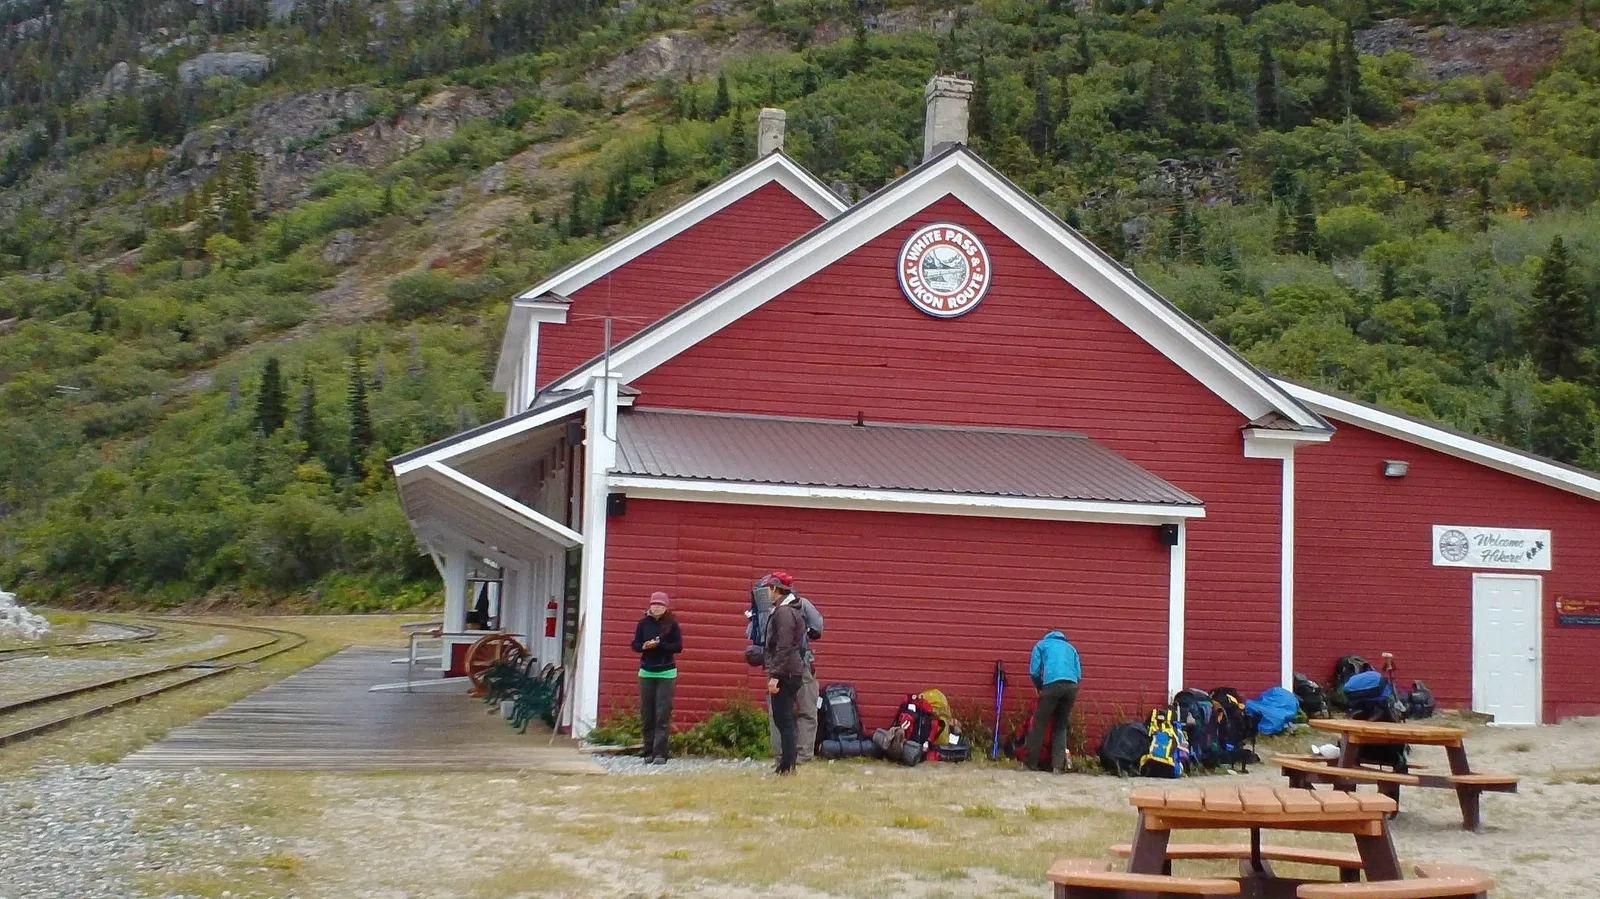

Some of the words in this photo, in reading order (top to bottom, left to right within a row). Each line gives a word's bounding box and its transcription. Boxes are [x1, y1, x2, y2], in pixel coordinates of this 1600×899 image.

[907, 230, 942, 261] WHITE
[945, 229, 977, 256] PASS
[970, 257, 980, 267] &
[906, 266, 944, 309] YUKON
[947, 273, 983, 309] ROUTE
[1473, 533, 1525, 548] Welcome
